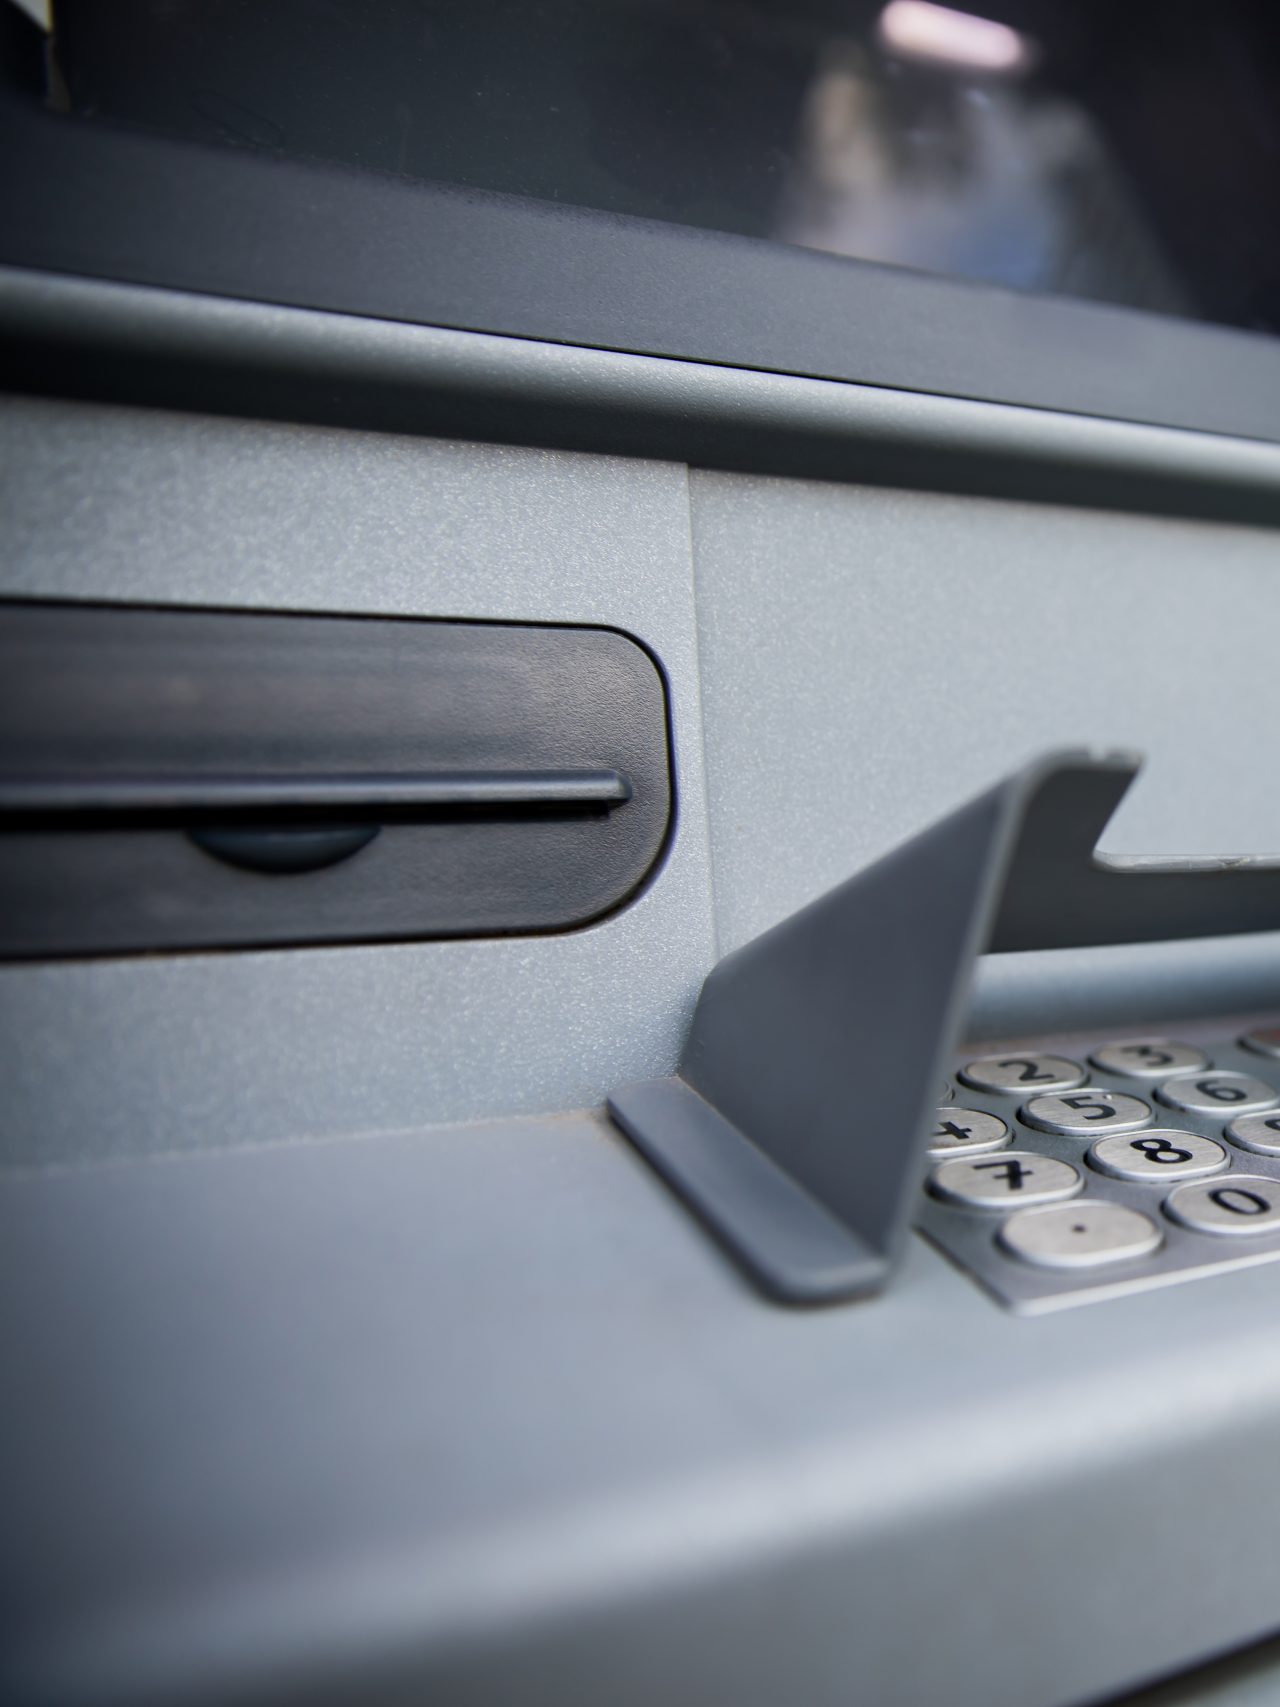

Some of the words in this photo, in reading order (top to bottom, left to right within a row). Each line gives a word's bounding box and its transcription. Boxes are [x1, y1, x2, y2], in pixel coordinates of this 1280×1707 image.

[1121, 1045, 1174, 1067] 3
[998, 1059, 1055, 1081] 2
[1196, 1079, 1247, 1102] 6
[1060, 1095, 1116, 1120] 5
[1130, 1138, 1193, 1164] 8
[972, 1160, 1035, 1190] 7
[1208, 1188, 1271, 1215] 0
